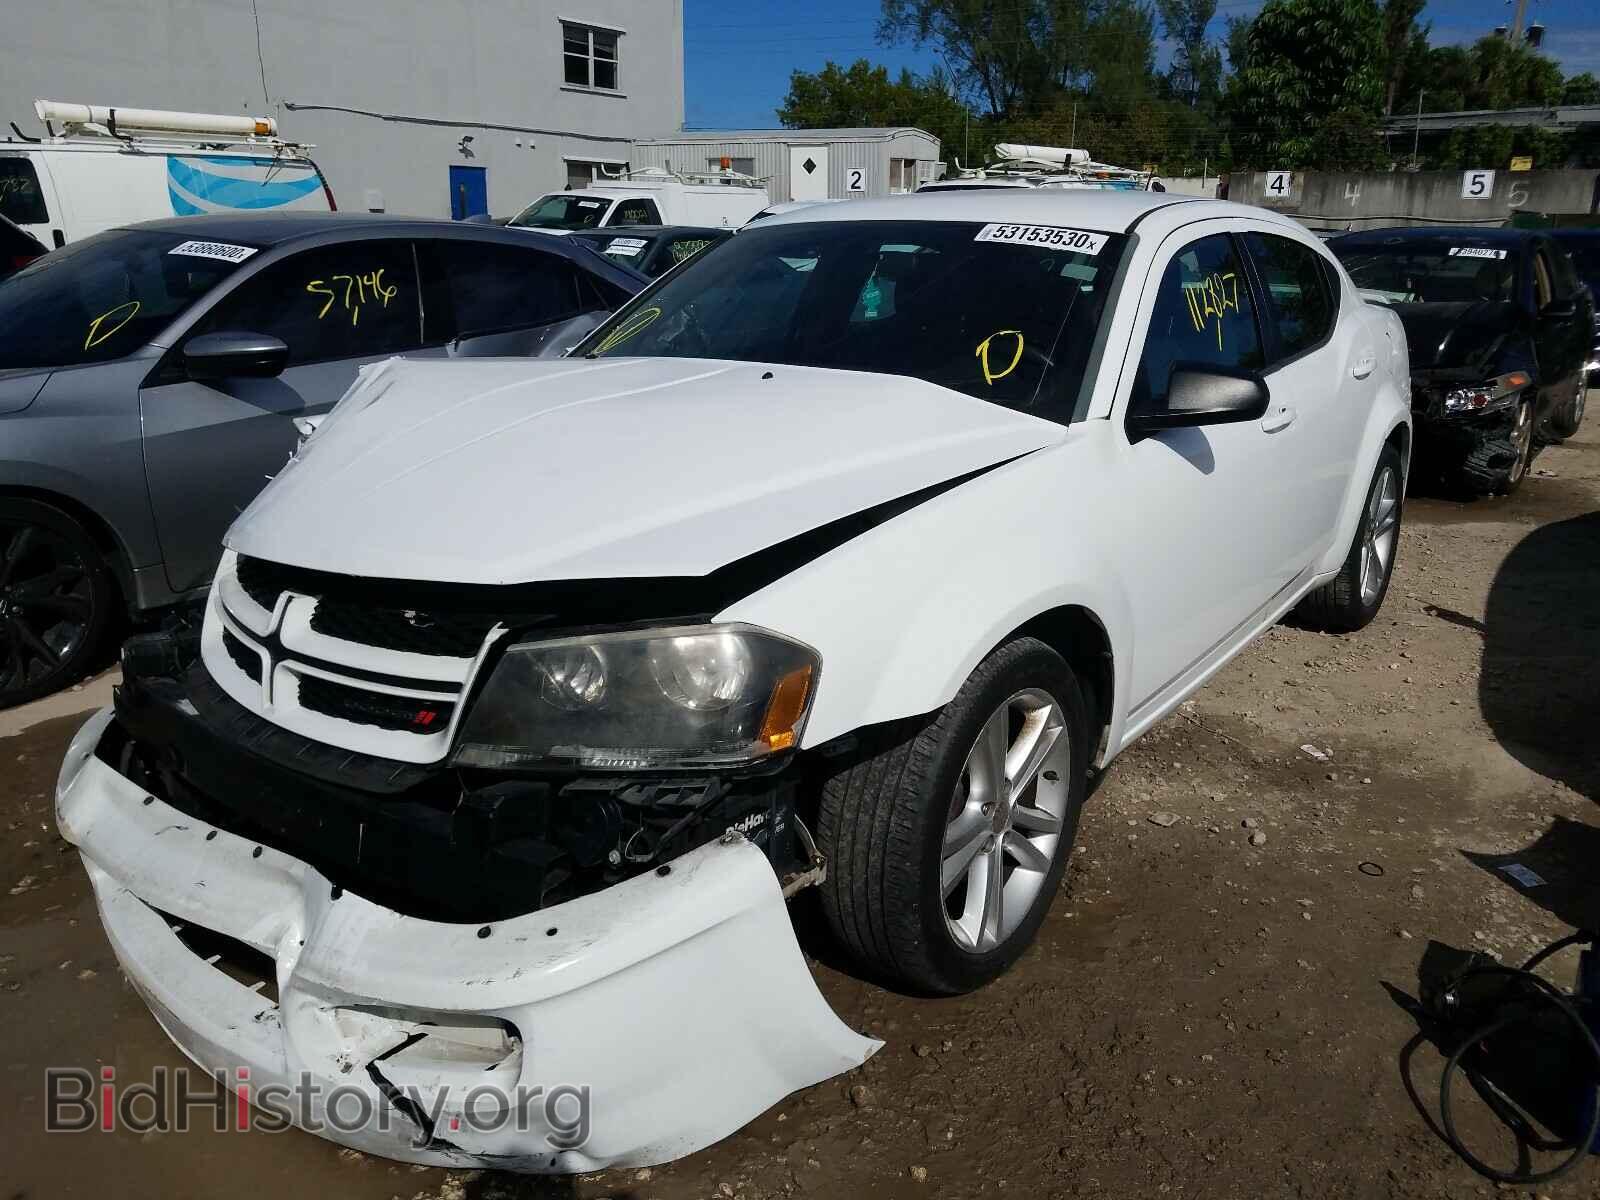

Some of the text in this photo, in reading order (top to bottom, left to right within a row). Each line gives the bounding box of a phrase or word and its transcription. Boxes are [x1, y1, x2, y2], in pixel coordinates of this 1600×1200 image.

[850, 170, 862, 190] 2
[1270, 173, 1285, 195] 4
[1469, 174, 1486, 196] 5
[1344, 181, 1361, 207] 4
